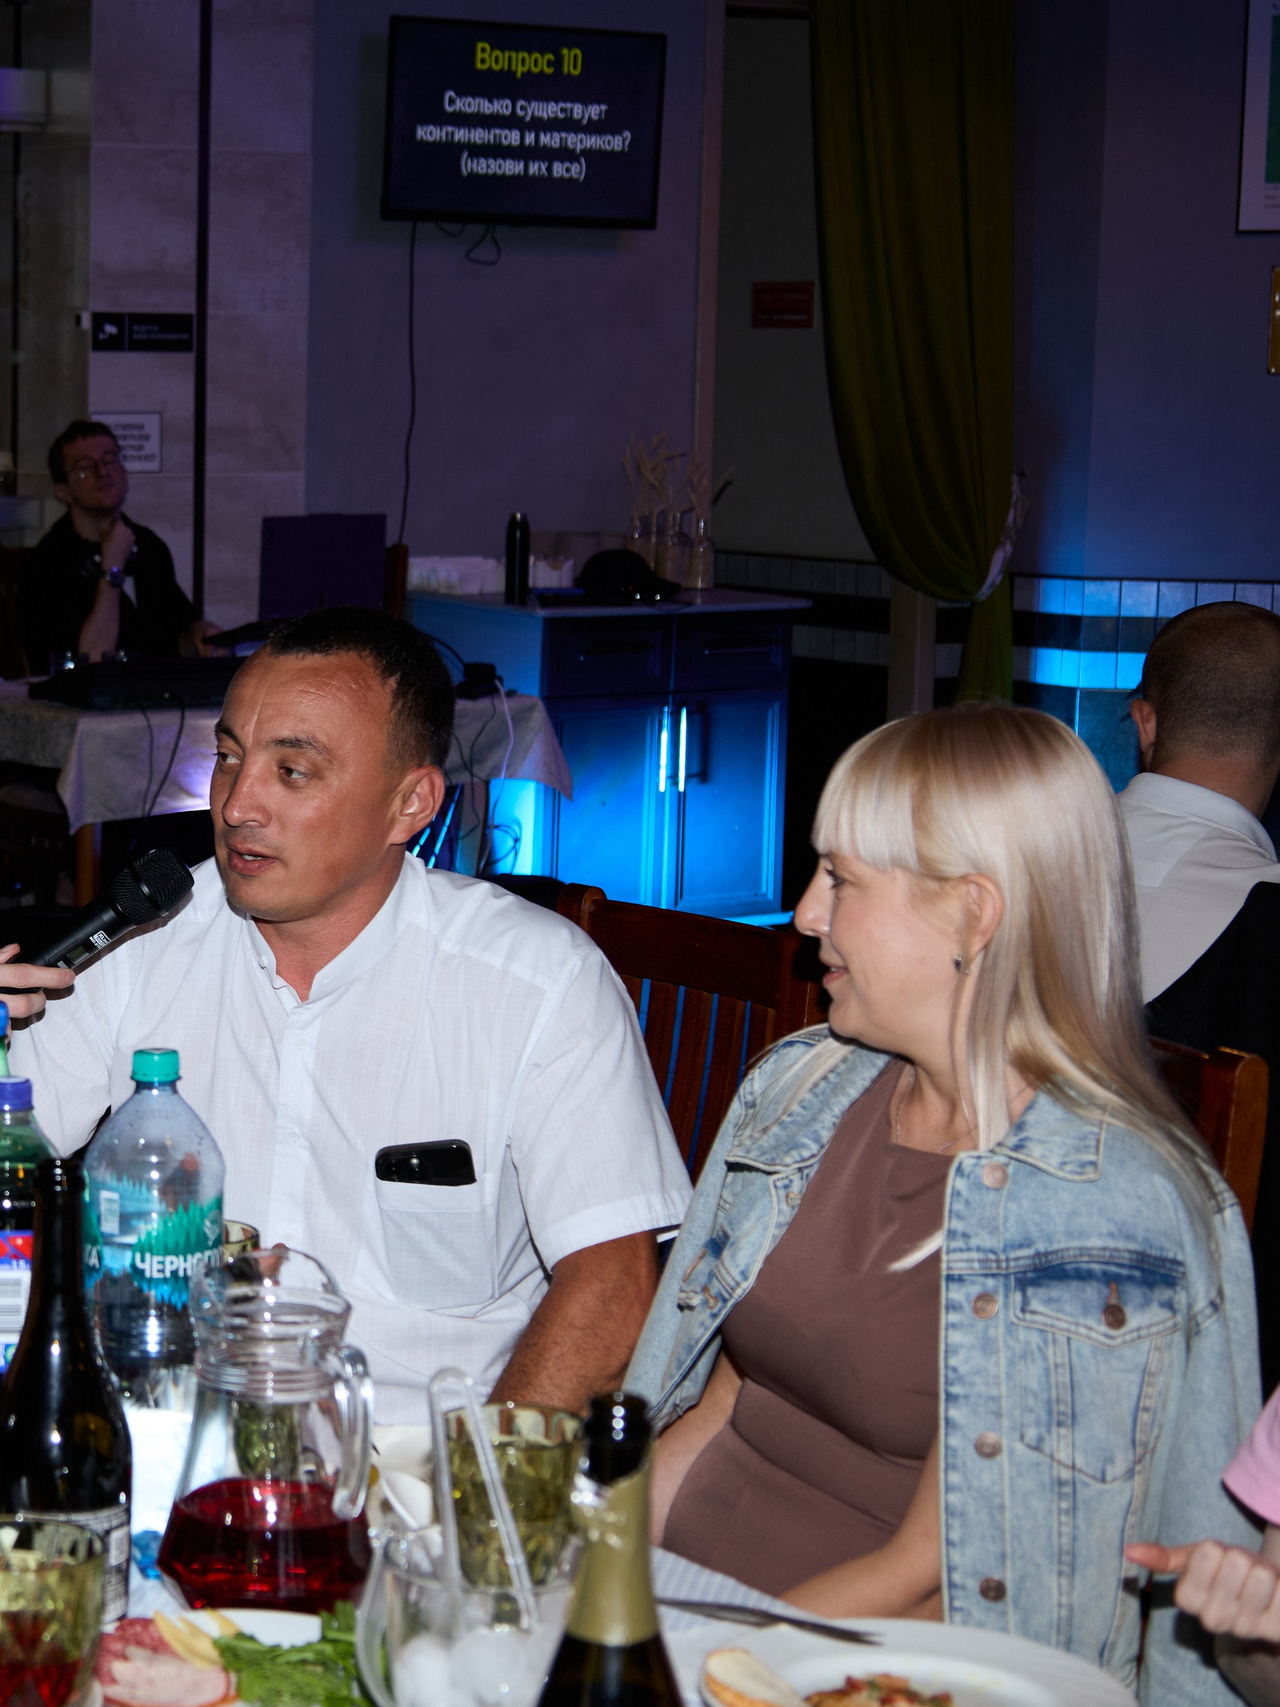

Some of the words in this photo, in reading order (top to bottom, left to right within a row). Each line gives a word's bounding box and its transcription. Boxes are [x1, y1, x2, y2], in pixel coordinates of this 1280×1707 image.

[475, 41, 555, 79] Вопрос
[561, 47, 583, 76] 10
[443, 89, 512, 116] Сколько
[515, 99, 608, 124] существует
[416, 124, 521, 147] континентов
[525, 130, 535, 147] и
[539, 130, 631, 154] материков?
[460, 151, 524, 177] (назови
[529, 159, 548, 177] их
[552, 156, 587, 182] все)
